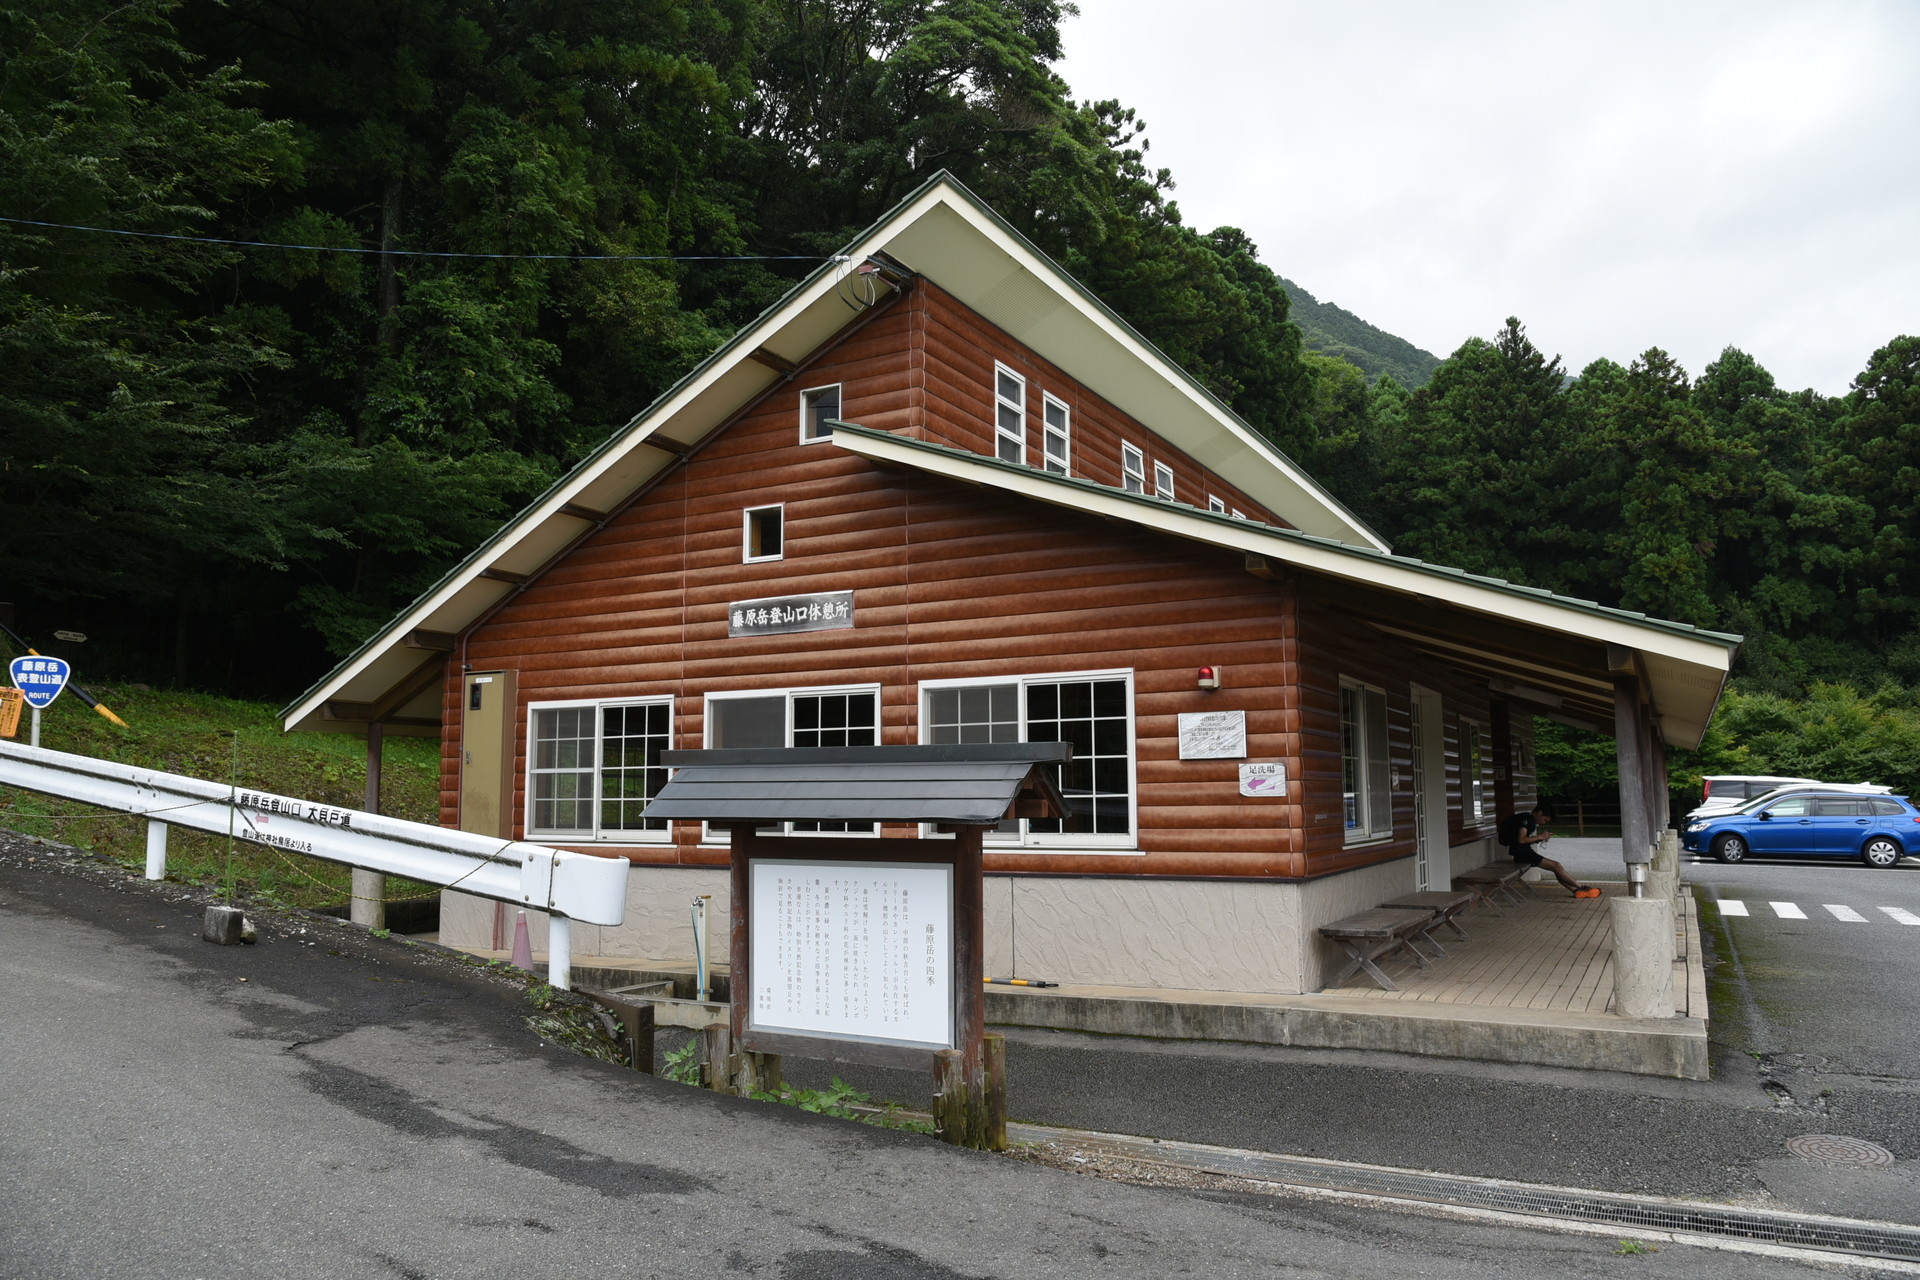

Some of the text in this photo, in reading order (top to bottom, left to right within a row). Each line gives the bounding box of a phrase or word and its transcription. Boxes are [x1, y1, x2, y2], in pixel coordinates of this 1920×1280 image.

[732, 601, 849, 627] 藤原岳登山口休憩所
[21, 660, 59, 673] 藤原岳
[17, 673, 63, 685] 表登山道
[28, 691, 51, 700] ROUTE
[1249, 765, 1275, 775] 足洗場
[240, 792, 352, 828] 藤原岳登山口 大貝戸道
[925, 923, 936, 986] 藤原岳の四季
